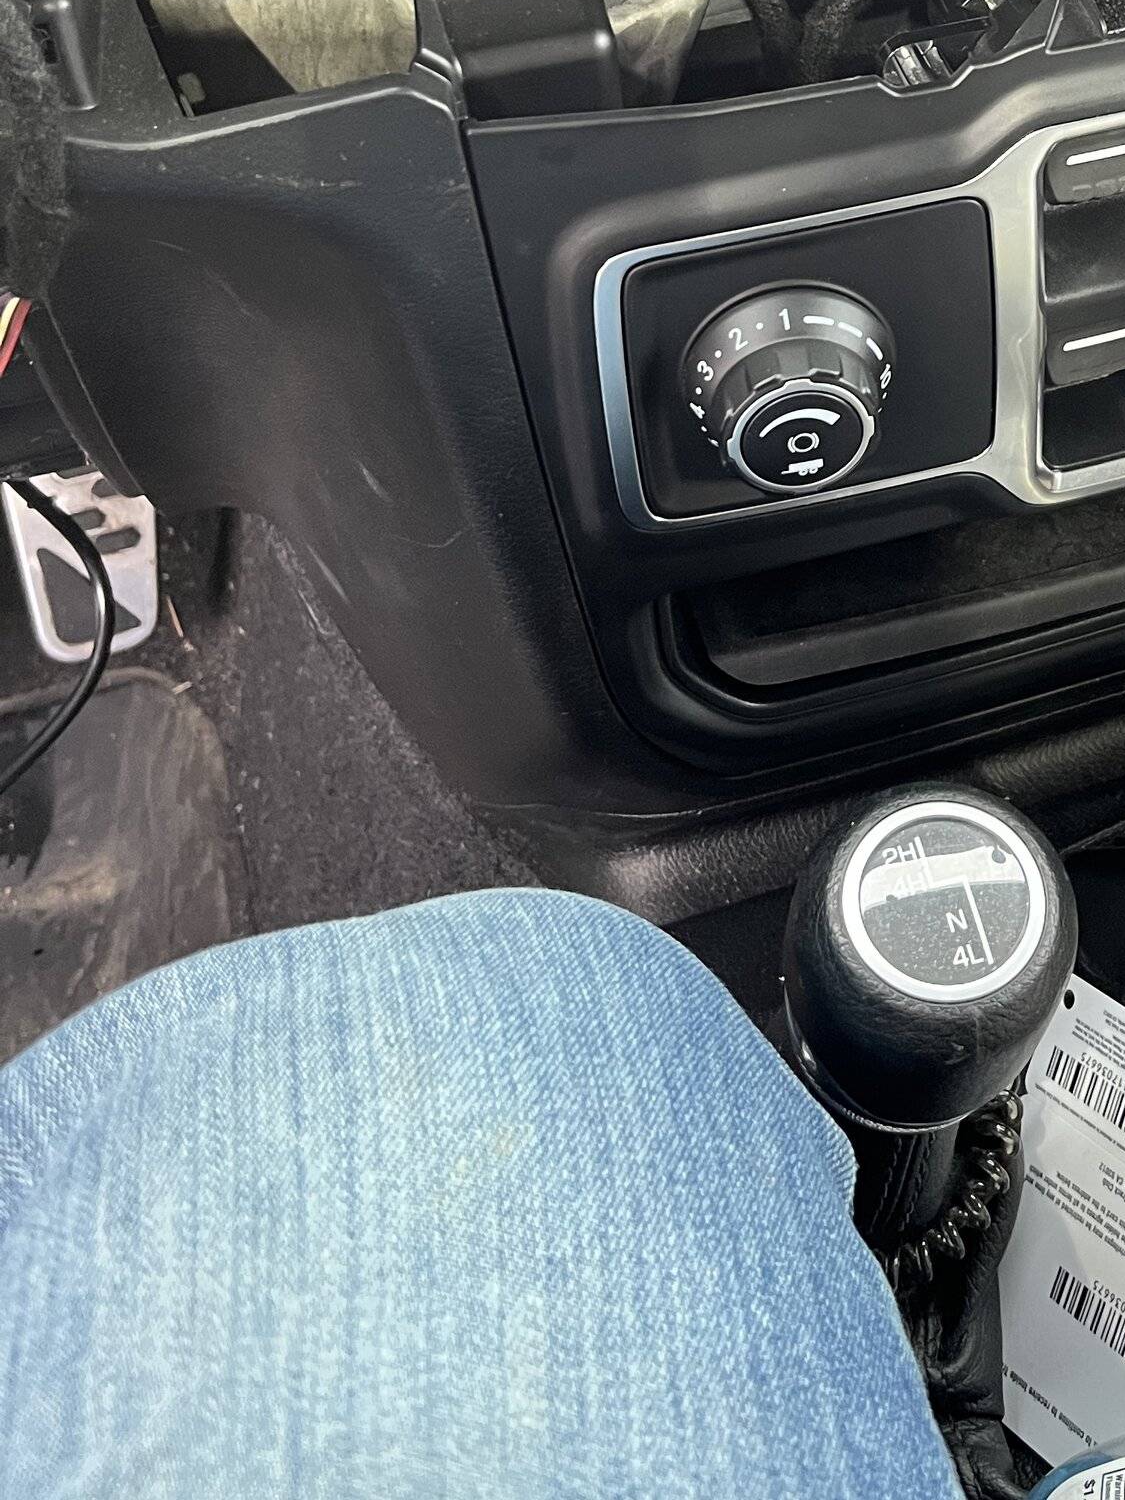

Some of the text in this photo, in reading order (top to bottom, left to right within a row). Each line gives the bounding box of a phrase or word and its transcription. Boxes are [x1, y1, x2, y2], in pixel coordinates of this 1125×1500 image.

[778, 308, 791, 331] 1
[728, 327, 748, 351] 2
[697, 360, 714, 382] 3
[689, 402, 706, 419] 4
[882, 841, 918, 865] 2H
[946, 908, 968, 933] N
[953, 943, 985, 967] 4L
